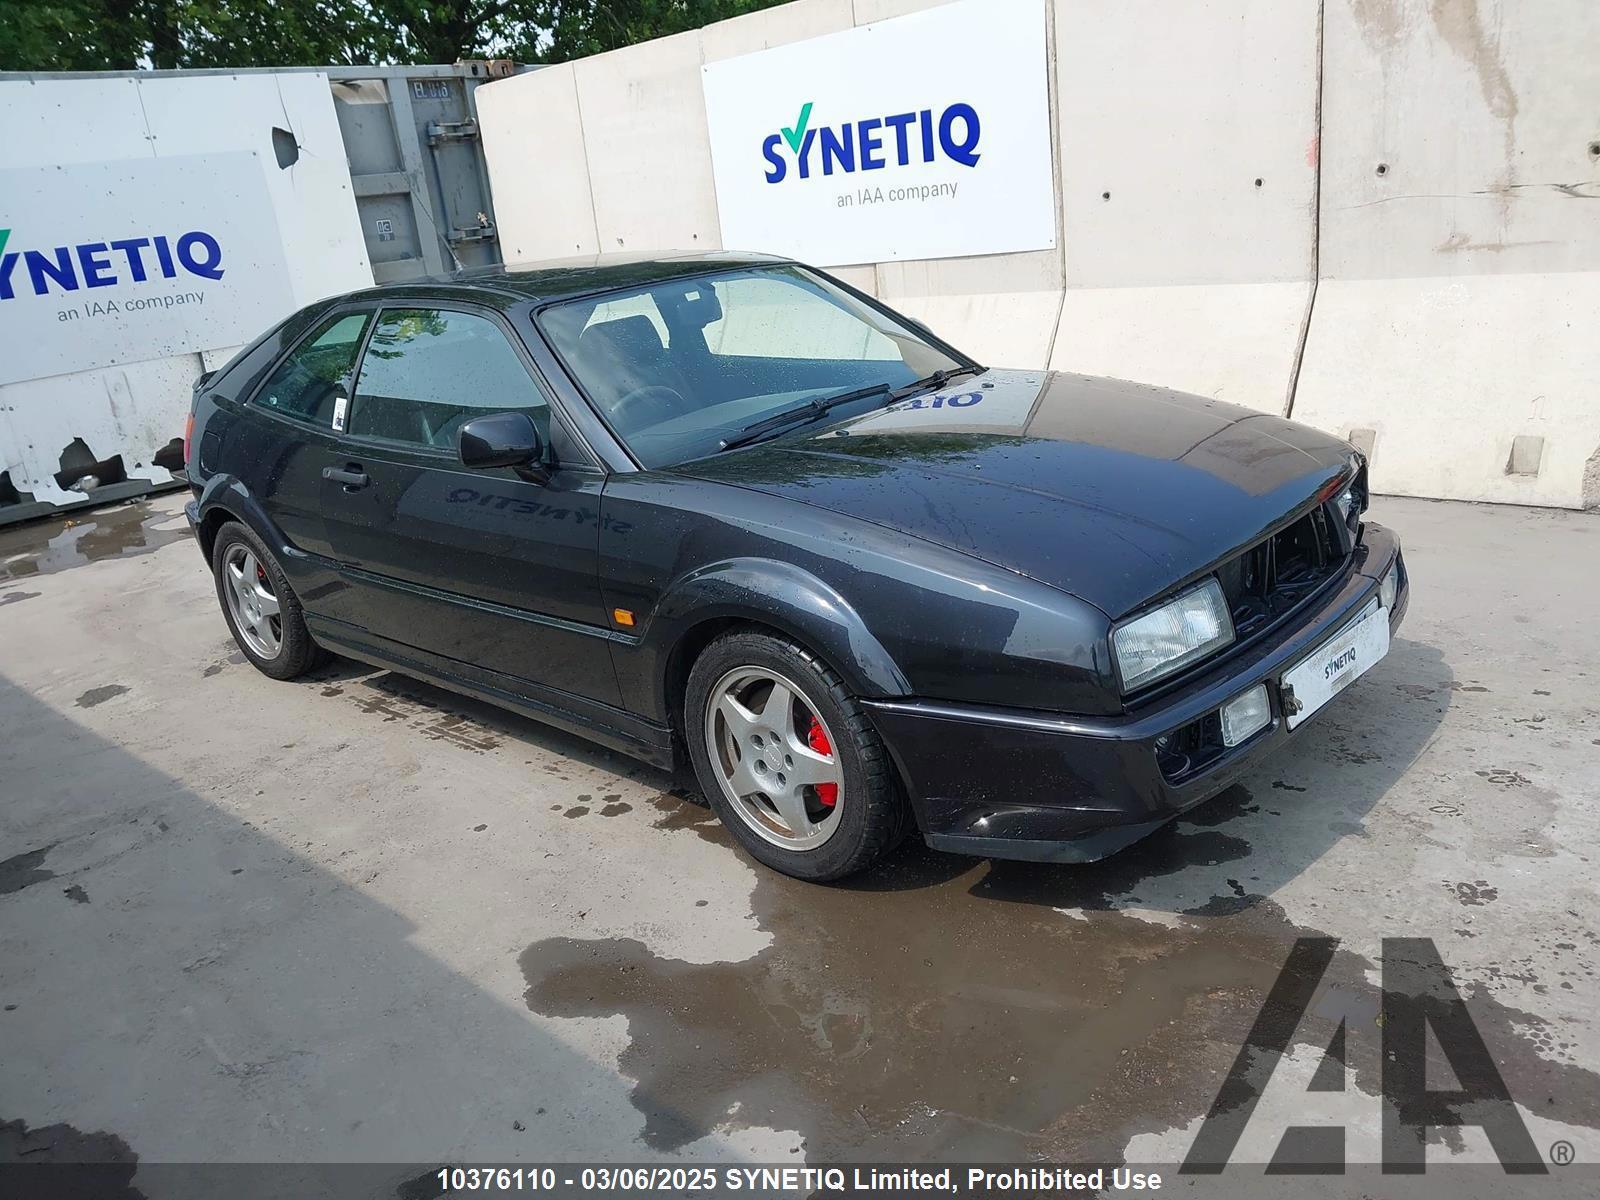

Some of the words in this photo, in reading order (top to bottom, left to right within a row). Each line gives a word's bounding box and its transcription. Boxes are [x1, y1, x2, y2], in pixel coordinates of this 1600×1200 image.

[762, 102, 981, 184] SYNETIQ
[837, 193, 853, 208] an
[858, 187, 884, 206] IAA
[888, 182, 958, 202] company
[57, 307, 80, 322] an
[84, 299, 120, 318] IAA
[125, 291, 205, 312] company
[1324, 647, 1356, 680] SYNETIQ
